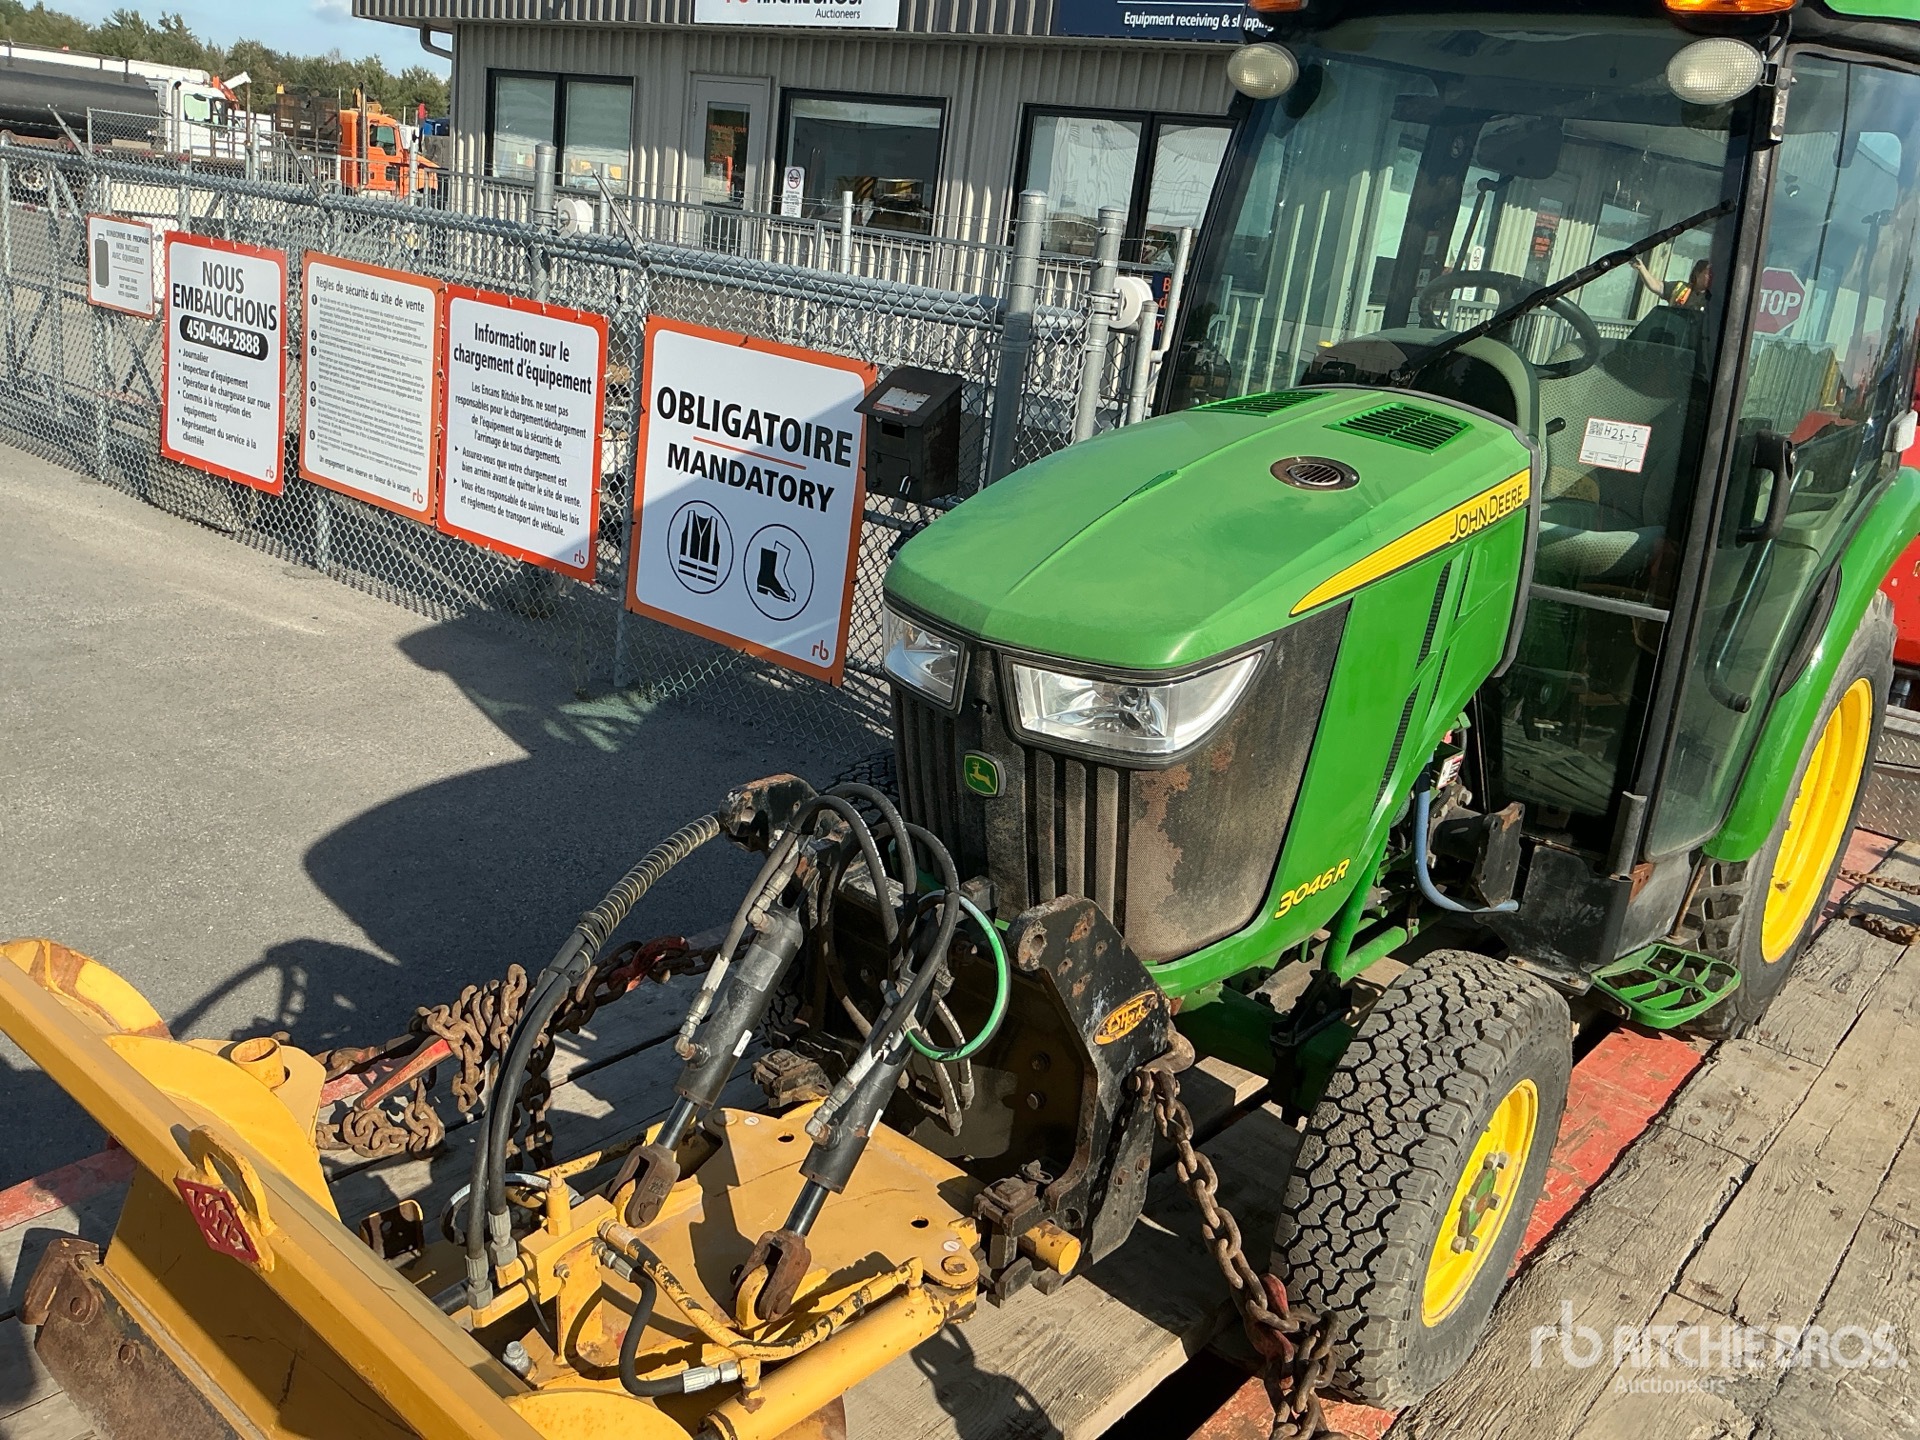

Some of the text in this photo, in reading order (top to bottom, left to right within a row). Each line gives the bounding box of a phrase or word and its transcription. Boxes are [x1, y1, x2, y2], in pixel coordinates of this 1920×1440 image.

[815, 8, 860, 19] Auctioneers
[1124, 11, 1174, 28] Equipment
[1176, 12, 1219, 31] receiving
[1222, 14, 1230, 27] &
[203, 261, 244, 294] NOUS
[173, 282, 277, 331] EMBAUCHONS
[315, 276, 424, 312] Règles de sécurité du site de vente
[1759, 289, 1801, 316] TOP
[186, 319, 260, 355] 450-464-2888
[474, 322, 570, 362] Information sur le
[183, 348, 209, 363] Journalier
[183, 362, 209, 377] Inspecteur
[453, 343, 514, 375] chargement
[182, 390, 202, 403] Commis
[208, 397, 213, 407] la
[214, 400, 240, 416] réception
[242, 407, 251, 418] des
[183, 375, 271, 410] Opérateur de chargeuse sur roue
[455, 395, 489, 411] responsables
[490, 405, 502, 416] pour
[504, 405, 509, 417] le
[472, 381, 568, 417] Les Encans Ritchie Bros. ne sont pas
[183, 404, 217, 422] équipements
[657, 386, 853, 468] OBLIGATOIRE
[181, 417, 256, 449] Représentant du service à la
[183, 431, 204, 446] clientèle
[471, 413, 478, 424] de
[515, 428, 523, 438] ou
[524, 428, 529, 440] la
[530, 431, 553, 447] sécurité
[554, 437, 562, 449] de
[462, 447, 567, 488] Assurez-vous que votre chargement est
[502, 438, 510, 450] de
[511, 440, 523, 454] tous
[523, 444, 562, 465] chargements.
[265, 465, 274, 479] rb
[461, 461, 582, 508] bien arrimé avant de quitter le site de vente.
[667, 442, 835, 512] MANDATORY
[412, 488, 423, 504] rb
[461, 478, 580, 526] Vous êtes responsable de suivre tous les lois
[1449, 484, 1523, 540] JOHN DEERE
[460, 495, 565, 537] et règlements de transport de véhicule.
[573, 549, 585, 565] rb
[811, 639, 829, 661] rb
[1274, 858, 1350, 919] 3046R
